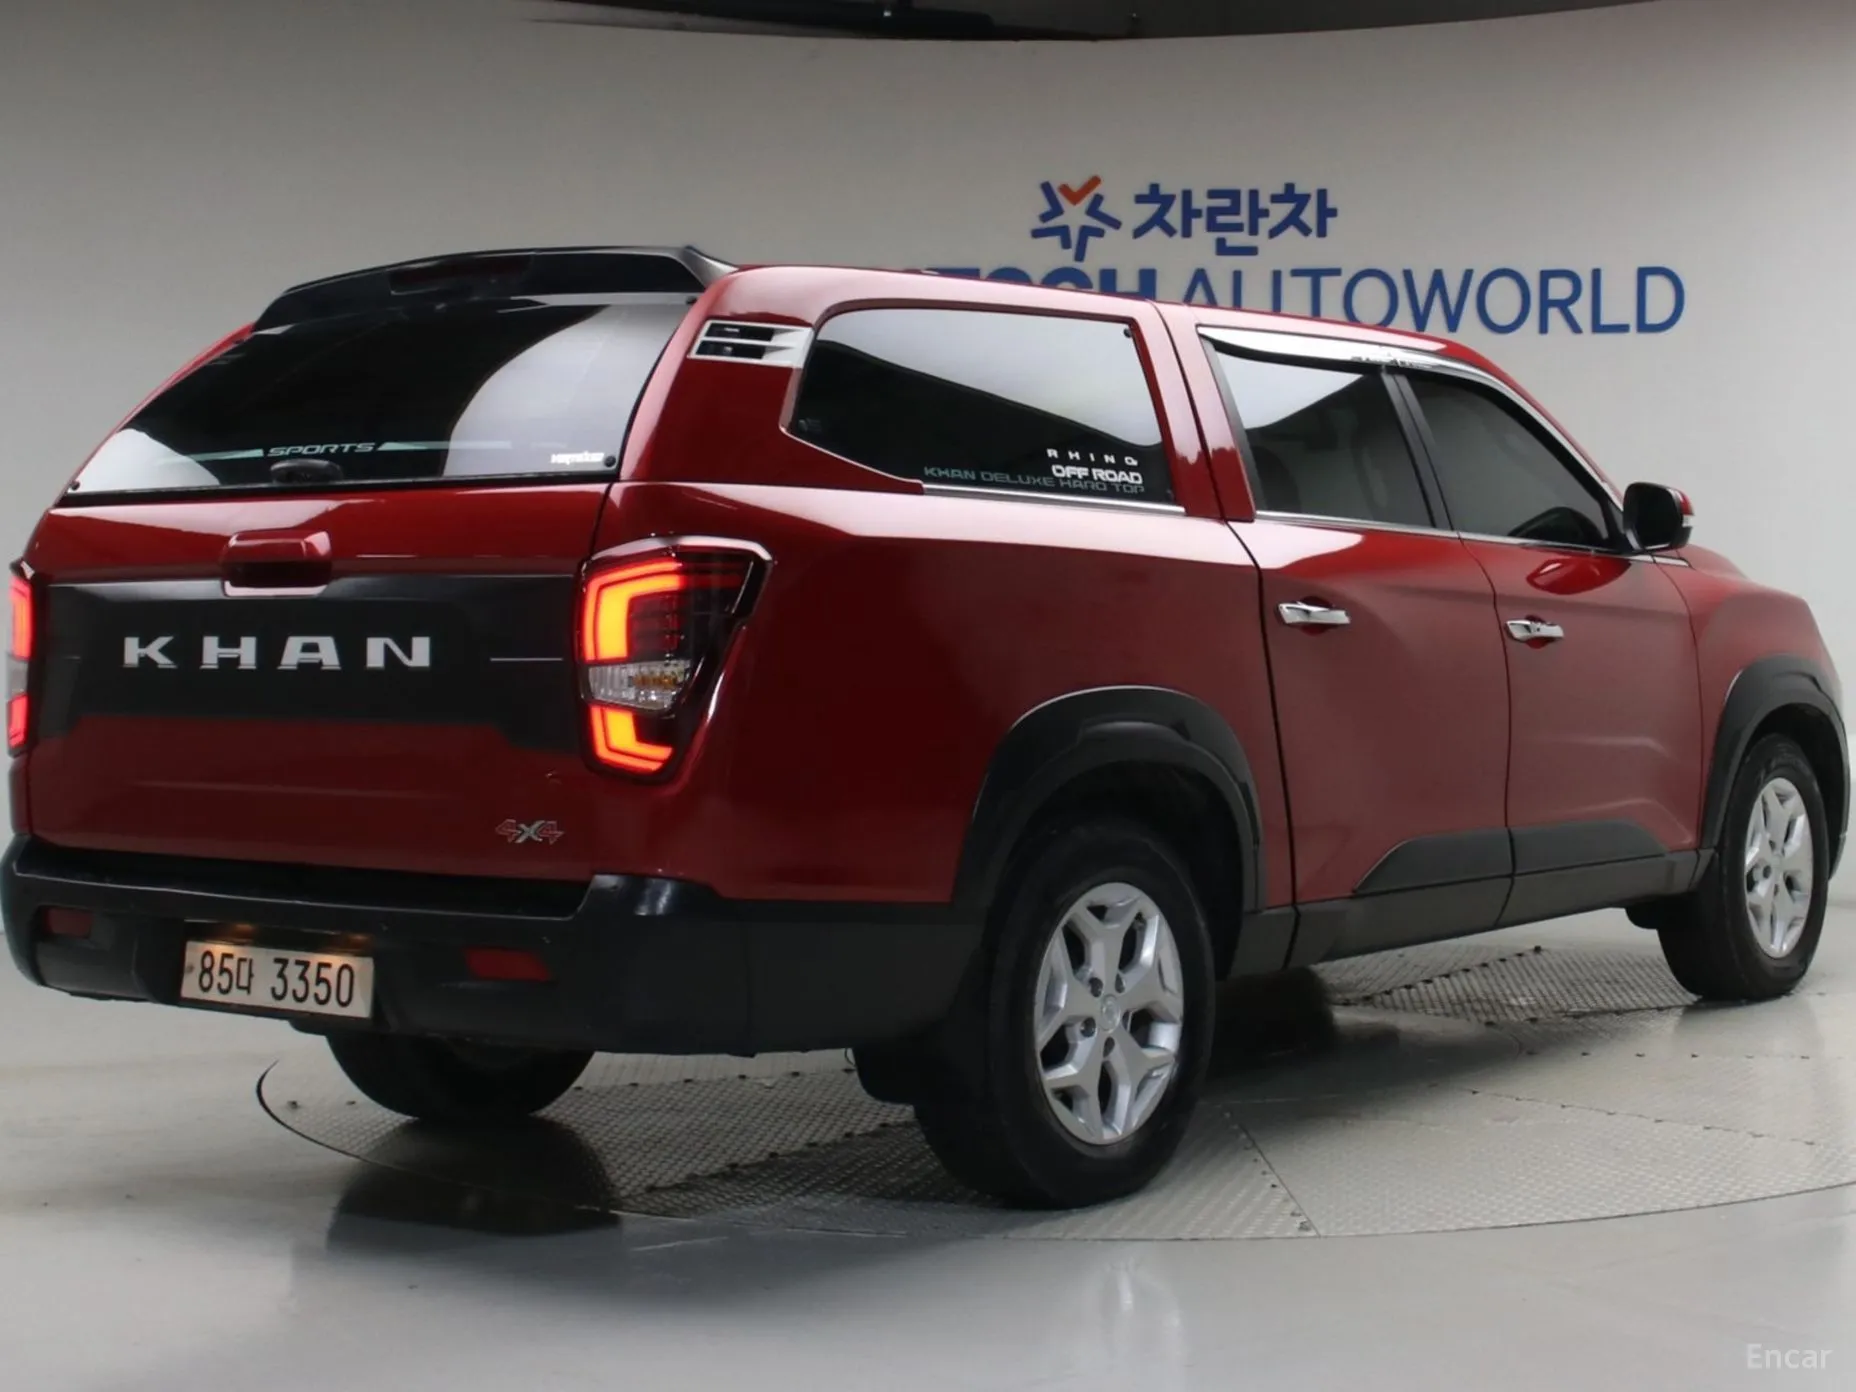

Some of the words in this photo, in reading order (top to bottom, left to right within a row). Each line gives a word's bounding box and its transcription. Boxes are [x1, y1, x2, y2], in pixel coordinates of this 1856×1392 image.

[1132, 182, 1338, 256] 차란차
[1183, 266, 1686, 335] AUTOWORLD
[267, 442, 376, 457] SPORTS
[923, 466, 976, 480] KHAN
[980, 471, 1056, 488] DELUXE
[1051, 464, 1089, 479] OFF
[1091, 467, 1143, 485] ROAD
[123, 635, 431, 669] KHAN
[198, 950, 255, 995] 85다
[271, 957, 355, 1008] 3350
